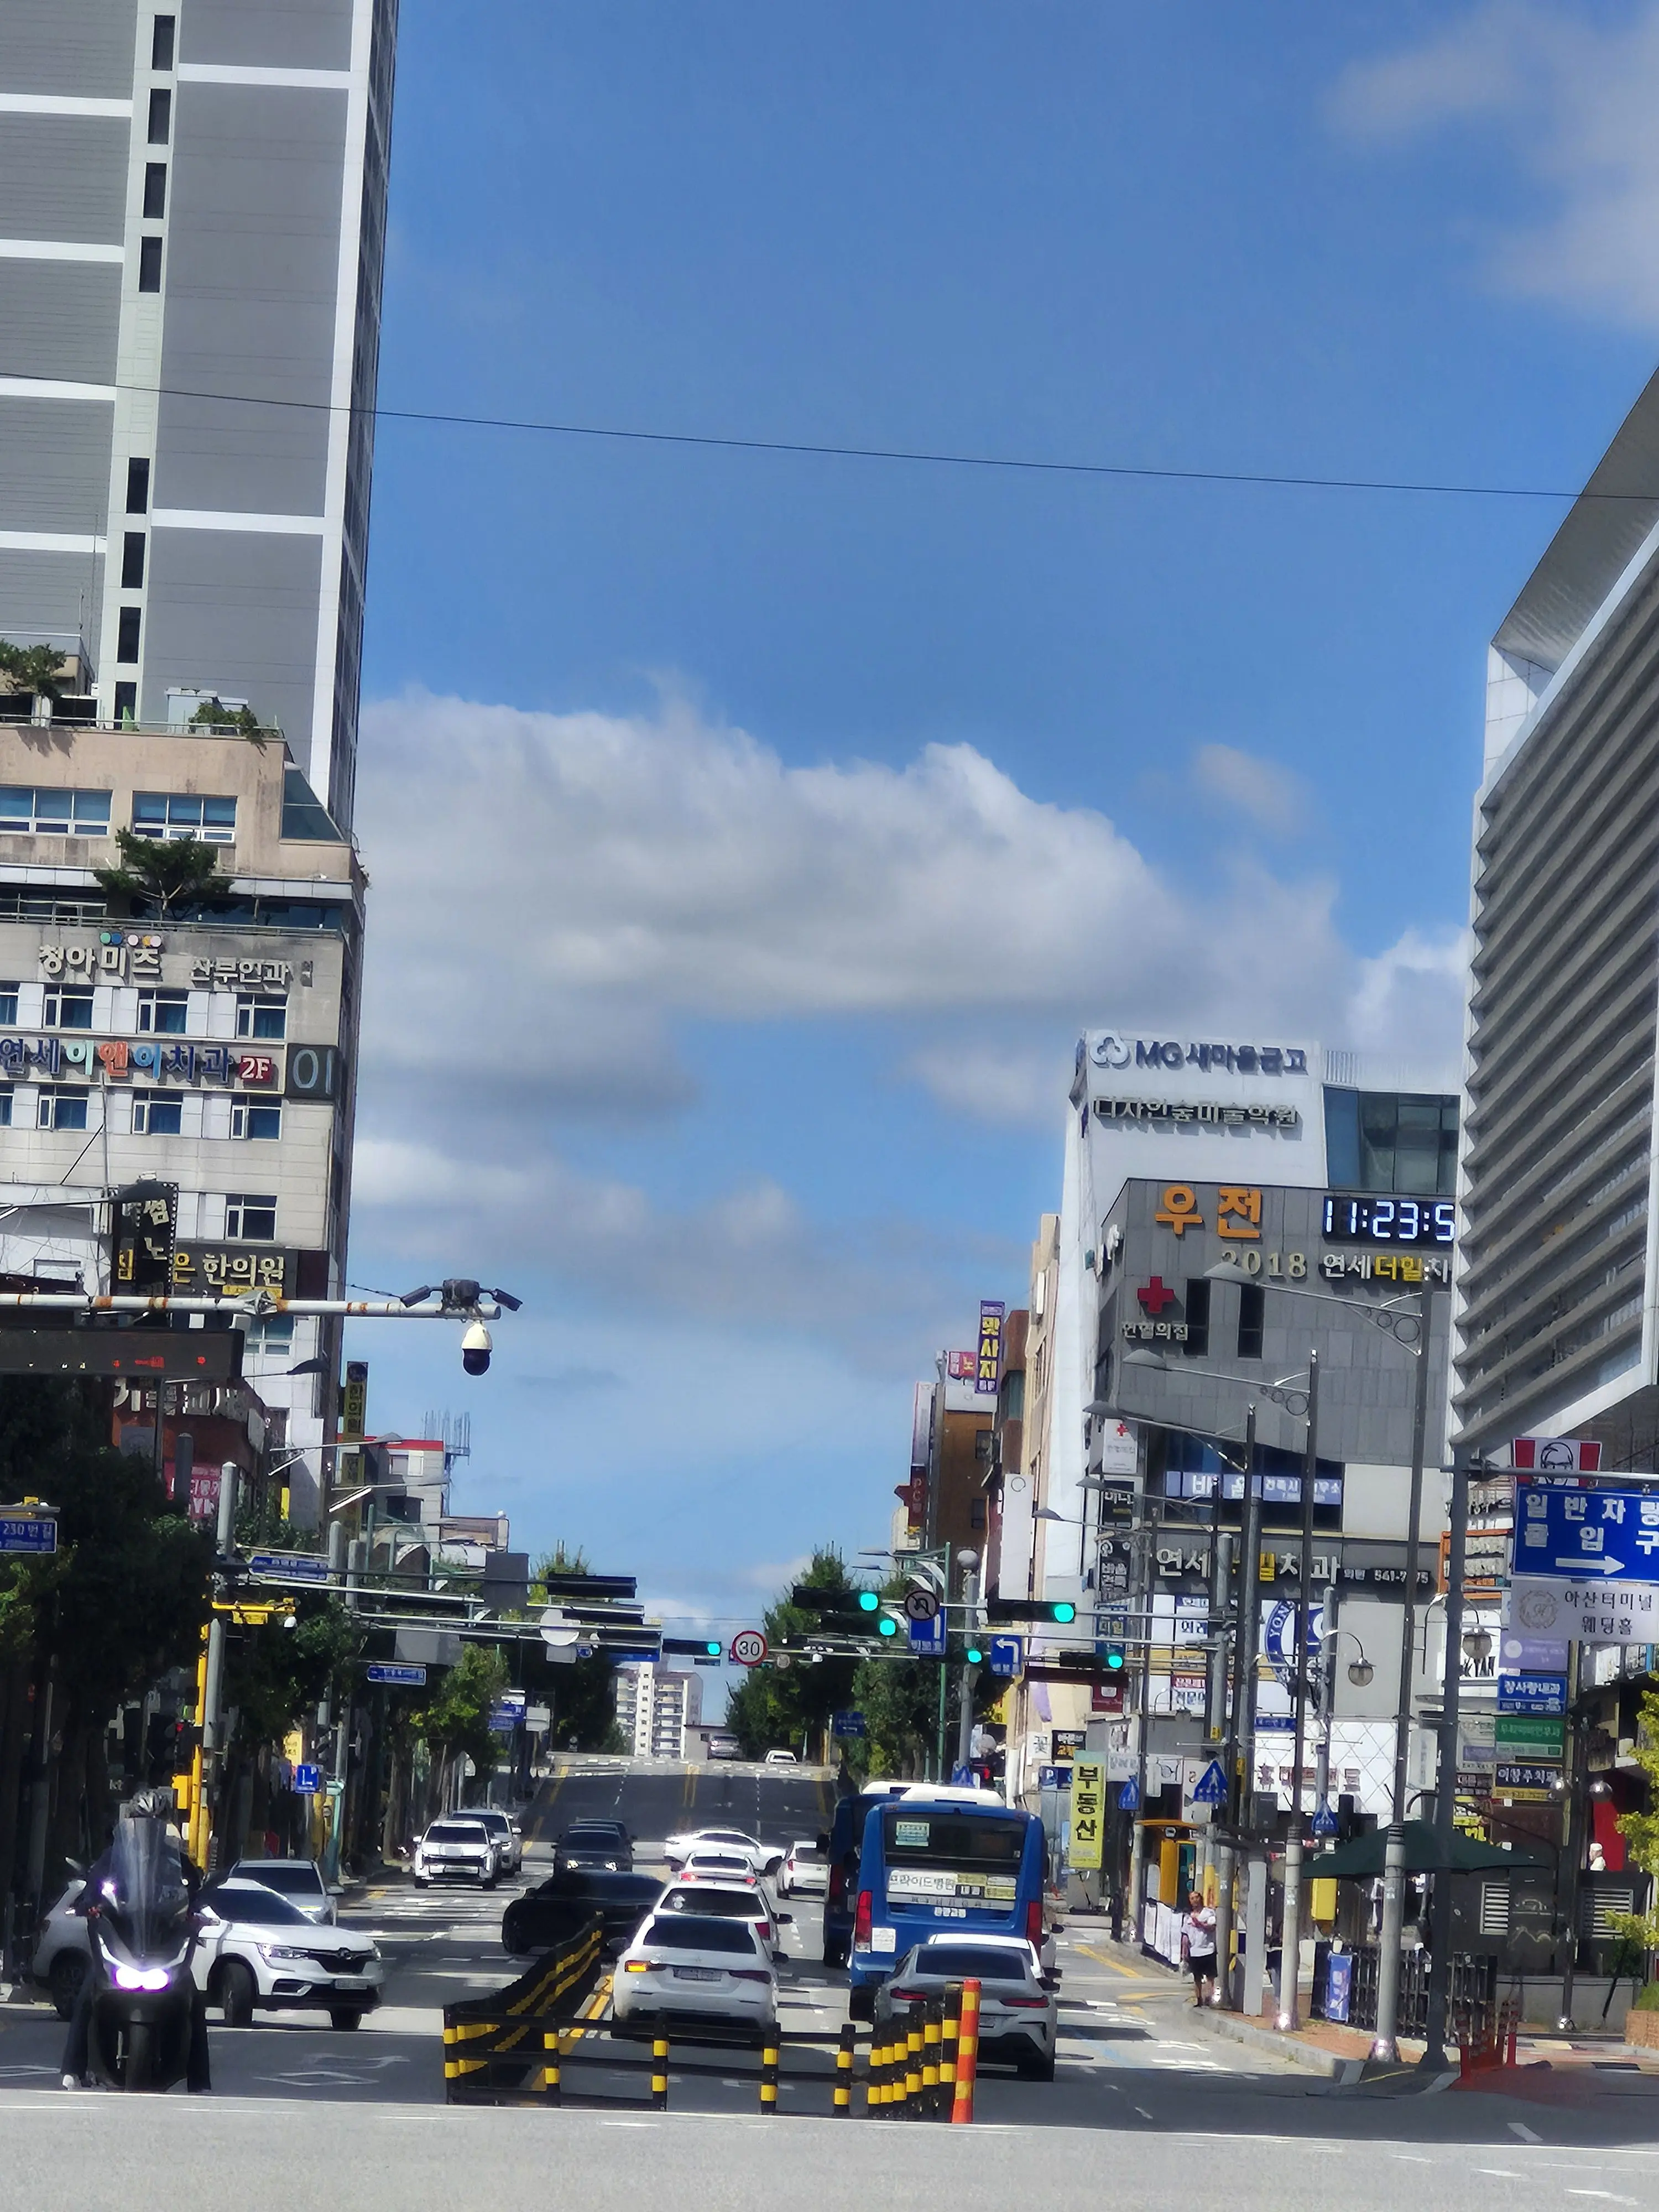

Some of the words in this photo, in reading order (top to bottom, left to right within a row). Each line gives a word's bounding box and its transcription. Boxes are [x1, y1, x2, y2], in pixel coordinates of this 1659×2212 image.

[39, 945, 160, 977] 청아미즈
[242, 1057, 270, 1079] 2F
[203, 1253, 284, 1288] 한의원
[1564, 1590, 1652, 1611] 아산터미널
[739, 1641, 760, 1656] 30
[1076, 1766, 1099, 1841] 부동산
